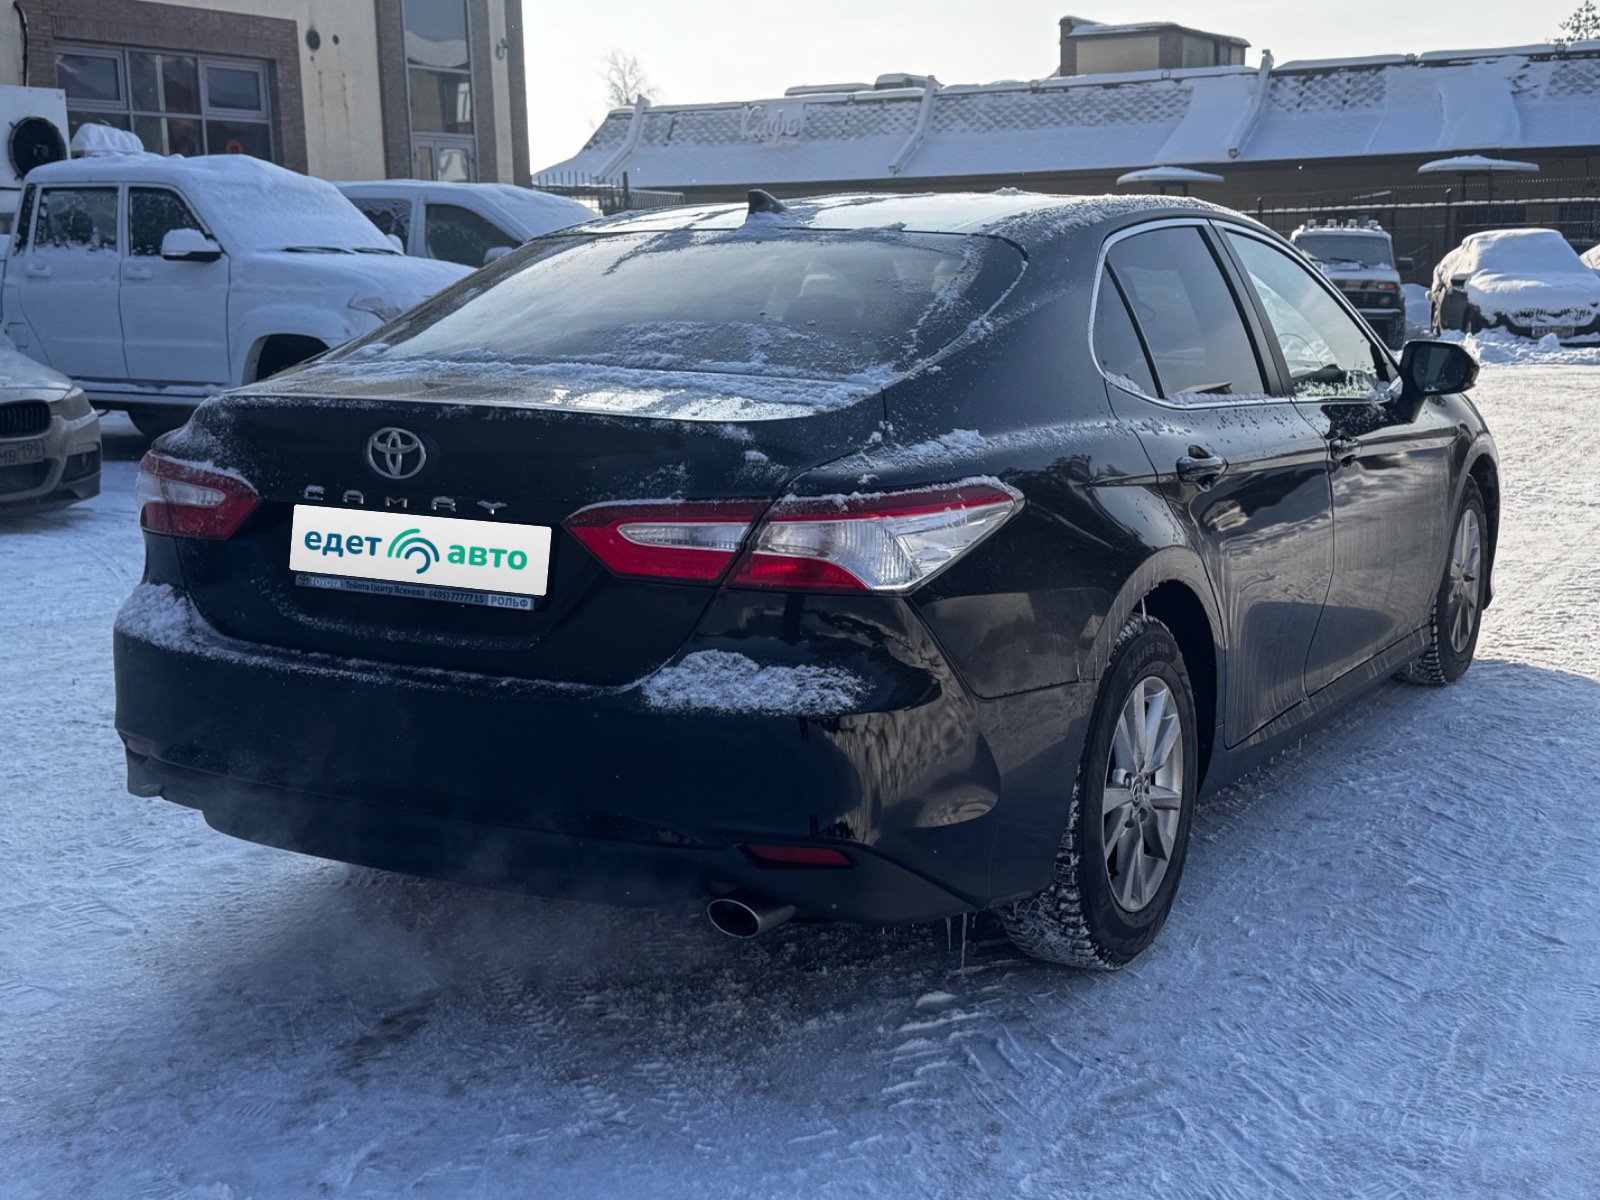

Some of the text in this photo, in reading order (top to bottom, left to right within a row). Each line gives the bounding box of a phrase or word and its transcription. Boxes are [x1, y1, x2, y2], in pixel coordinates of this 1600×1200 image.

[303, 484, 507, 514] CAMRY
[310, 576, 340, 588] TOYOTA
[346, 581, 370, 591] Тойота
[370, 583, 394, 594] Центр
[394, 585, 425, 597] Ясенево
[491, 594, 529, 608] РОЛЬФ
